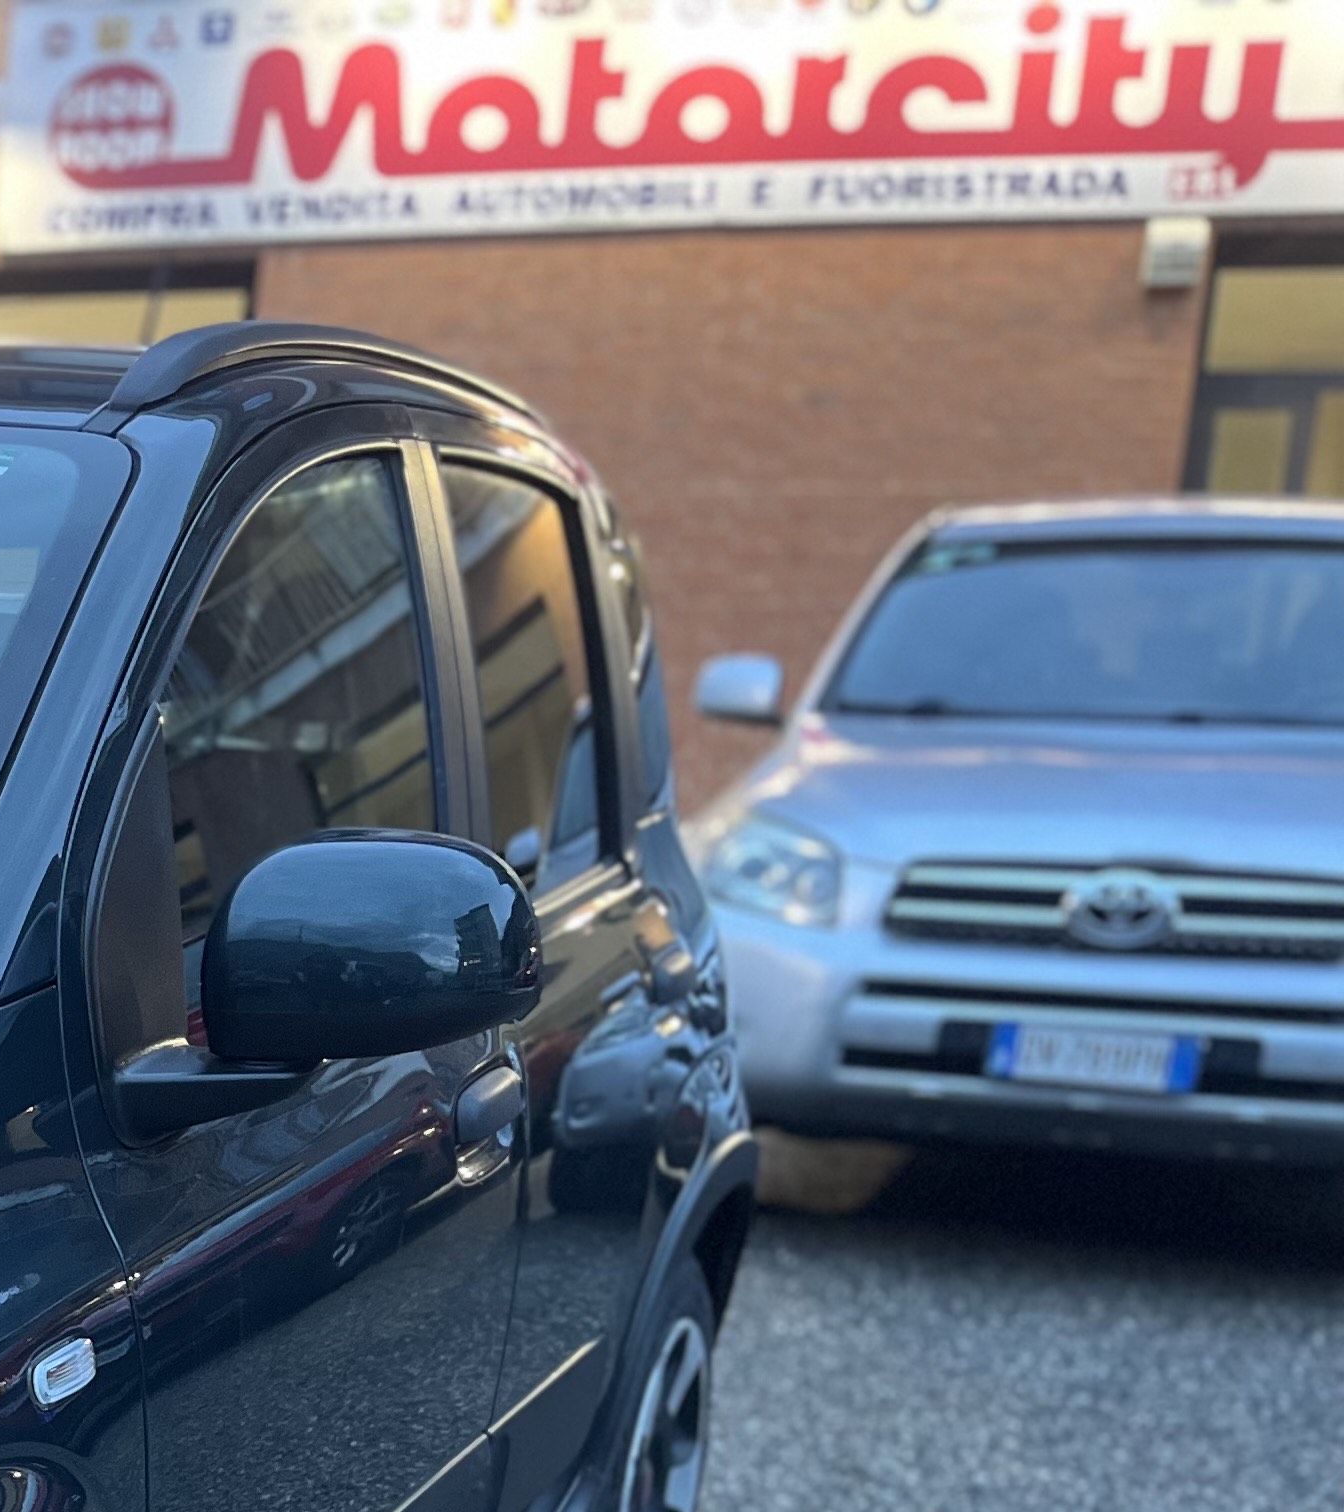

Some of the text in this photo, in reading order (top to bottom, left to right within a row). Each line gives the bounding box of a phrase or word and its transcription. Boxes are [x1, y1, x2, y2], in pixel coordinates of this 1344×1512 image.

[227, 4, 1285, 190] Motorcity
[48, 199, 217, 233] COMPRA
[245, 191, 420, 226] VENDITA
[455, 181, 717, 214] AUTOMOBILI
[752, 178, 770, 206] E
[811, 169, 1130, 205] FUORISTRADA
